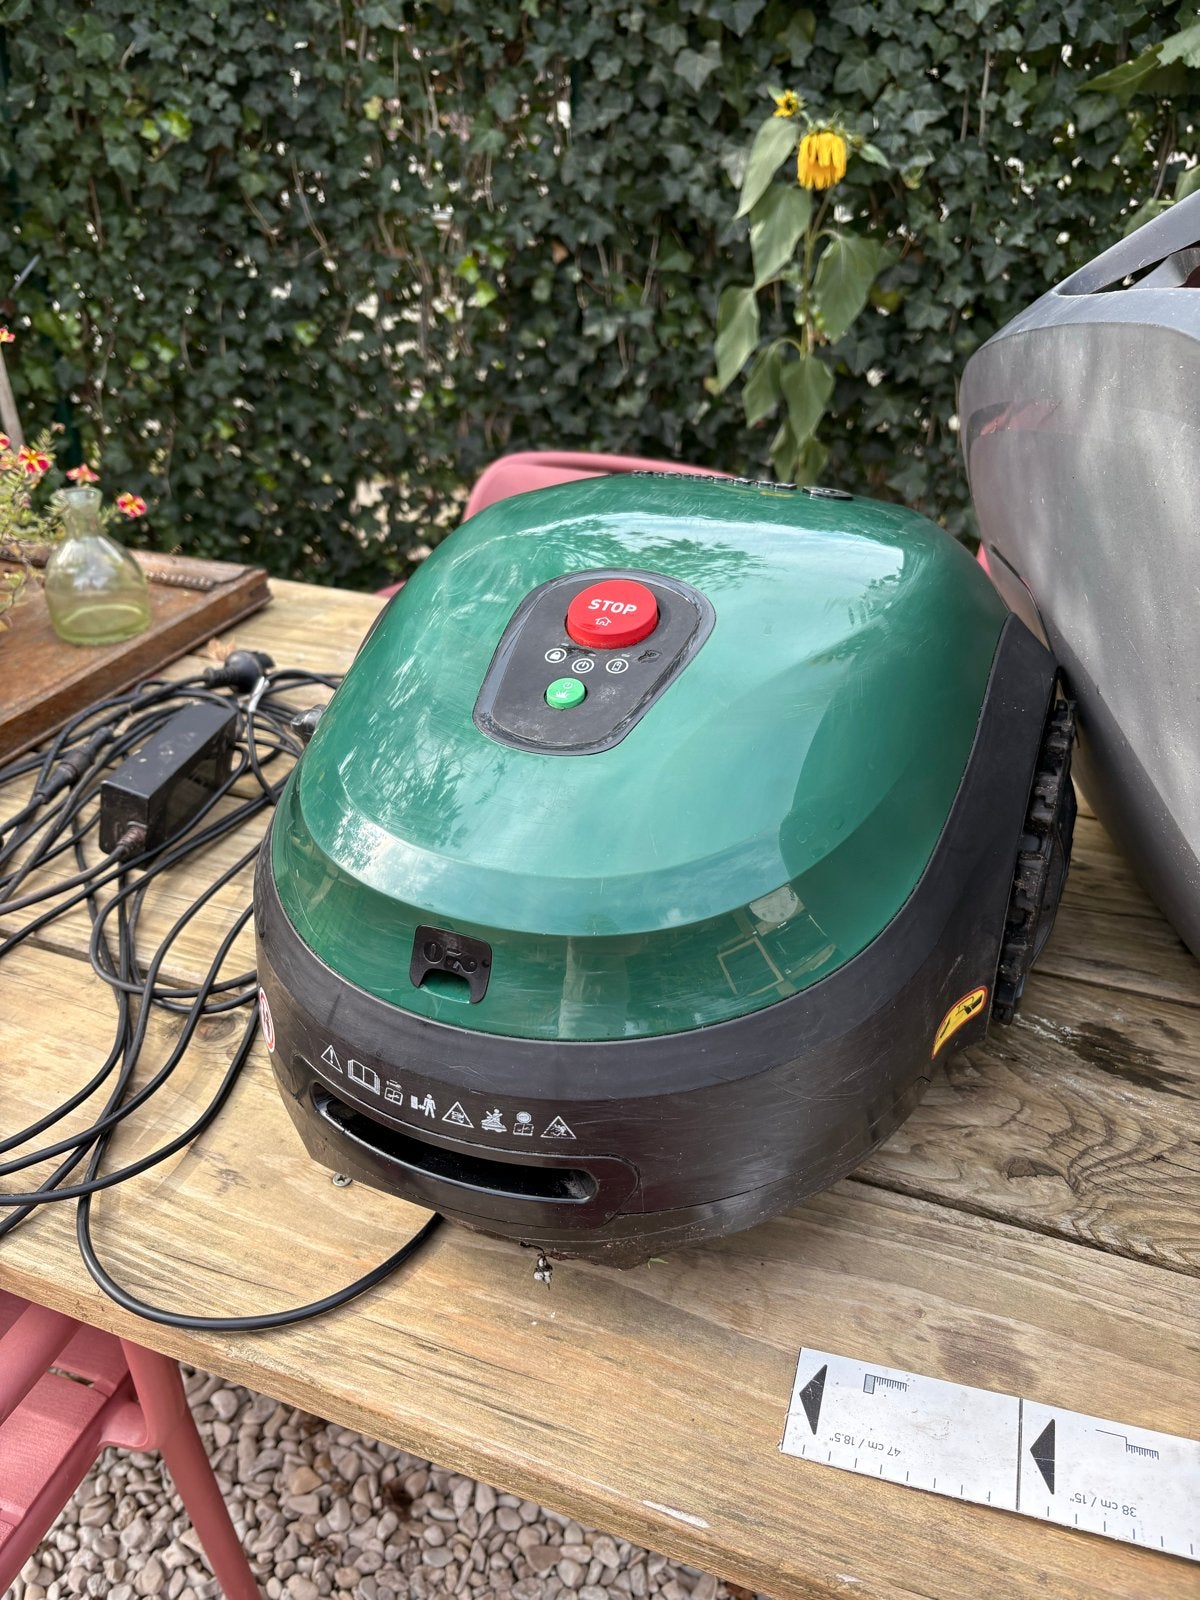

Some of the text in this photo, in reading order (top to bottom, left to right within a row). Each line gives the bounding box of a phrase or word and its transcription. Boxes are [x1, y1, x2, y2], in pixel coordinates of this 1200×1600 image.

[588, 599, 637, 615] STOP
[829, 1432, 901, 1457] 47 cm / 18.5"
[1069, 1492, 1137, 1518] 38 cm / 15"
